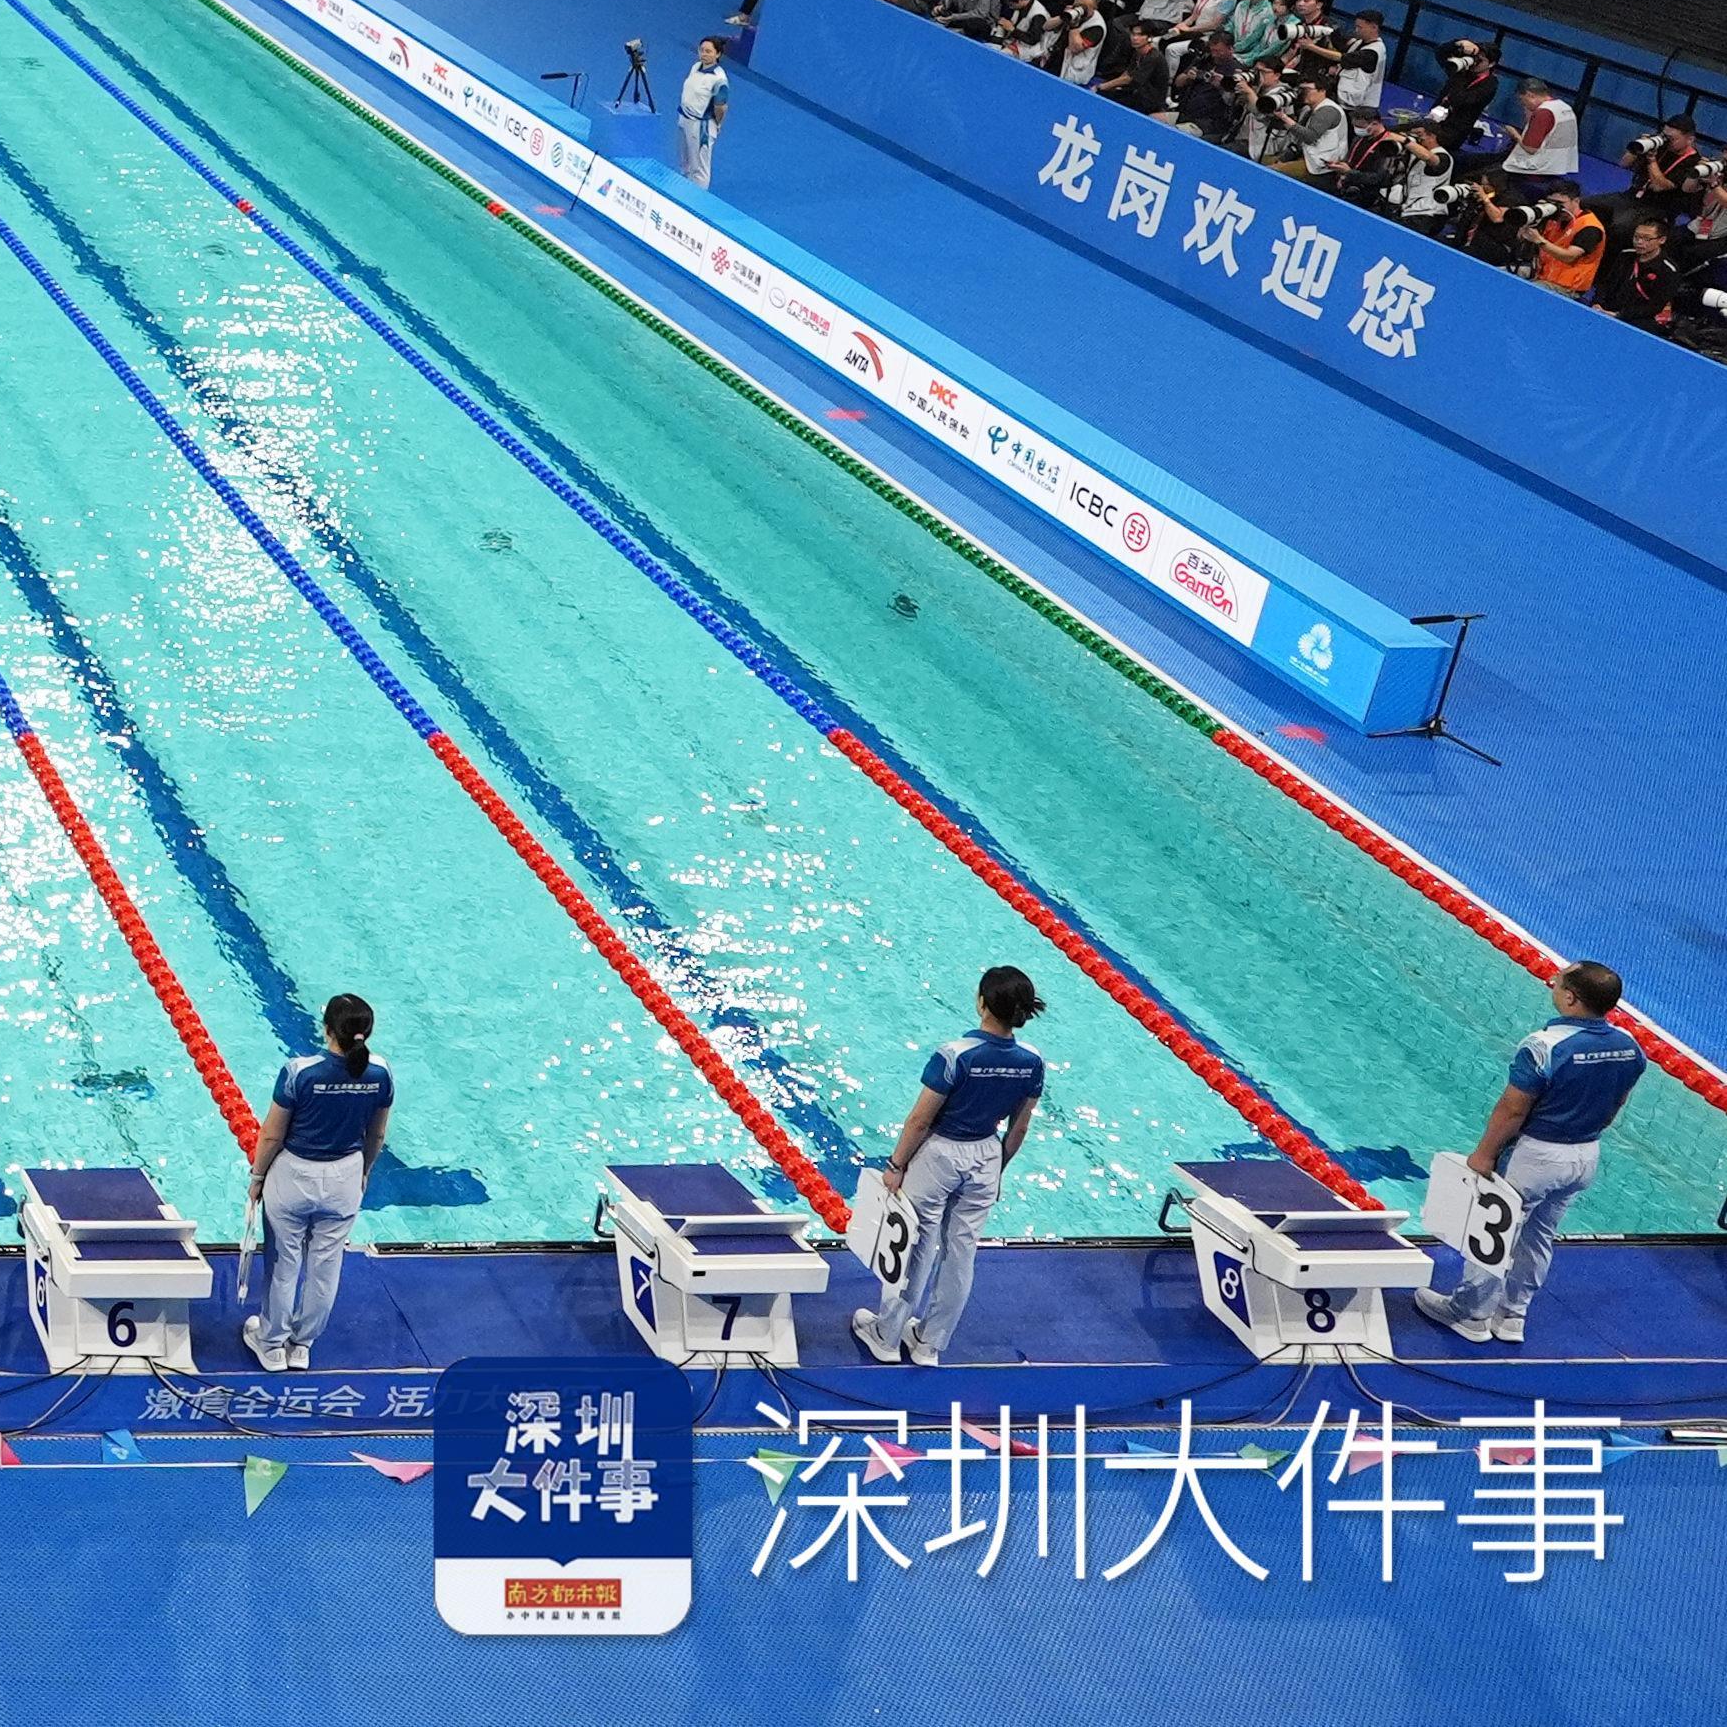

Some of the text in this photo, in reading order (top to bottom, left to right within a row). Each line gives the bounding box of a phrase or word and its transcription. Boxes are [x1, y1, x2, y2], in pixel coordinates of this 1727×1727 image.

[504, 114, 529, 138] ICBC
[1036, 114, 1438, 360] 龙岗欢迎您
[844, 349, 871, 374] ANTA
[907, 390, 970, 440] 中国人民保险
[929, 379, 959, 410] PICC
[1011, 438, 1061, 485] 中国电信
[1069, 480, 1119, 528] ICBC
[1187, 552, 1226, 586] 百岁山
[877, 1211, 911, 1285] 3
[1467, 1191, 1514, 1267] 3
[1219, 1267, 1241, 1303] 8
[107, 1301, 138, 1349] 6
[711, 1294, 743, 1342] 7
[1302, 1287, 1337, 1335] 8
